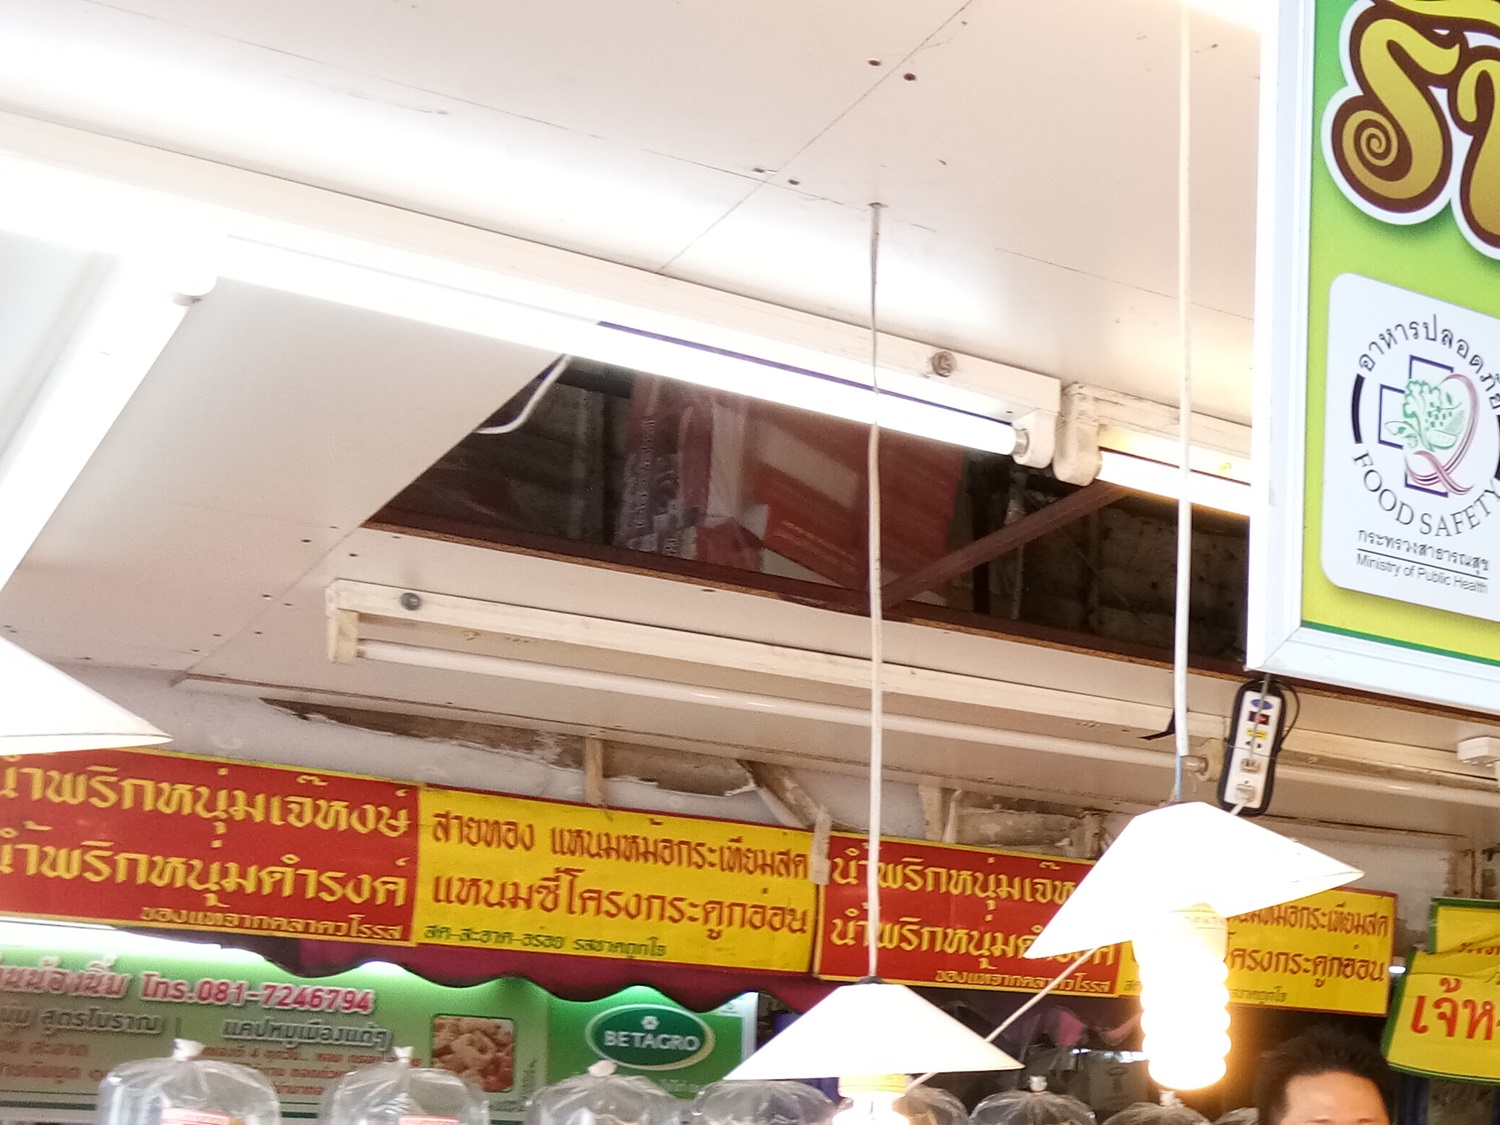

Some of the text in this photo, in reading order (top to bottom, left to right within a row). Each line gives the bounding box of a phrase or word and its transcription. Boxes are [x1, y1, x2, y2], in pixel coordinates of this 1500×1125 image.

[1352, 449, 1416, 526] FOOD
[1355, 552, 1489, 594] Ministry of Public Health
[1358, 528, 1490, 575] กระทรวงสาธารณสุข
[0, 753, 412, 838] นำพริกหนุ่มเจ๊หงษ์
[431, 811, 536, 851] สายทอง
[603, 1028, 700, 1053] BETAGRO
